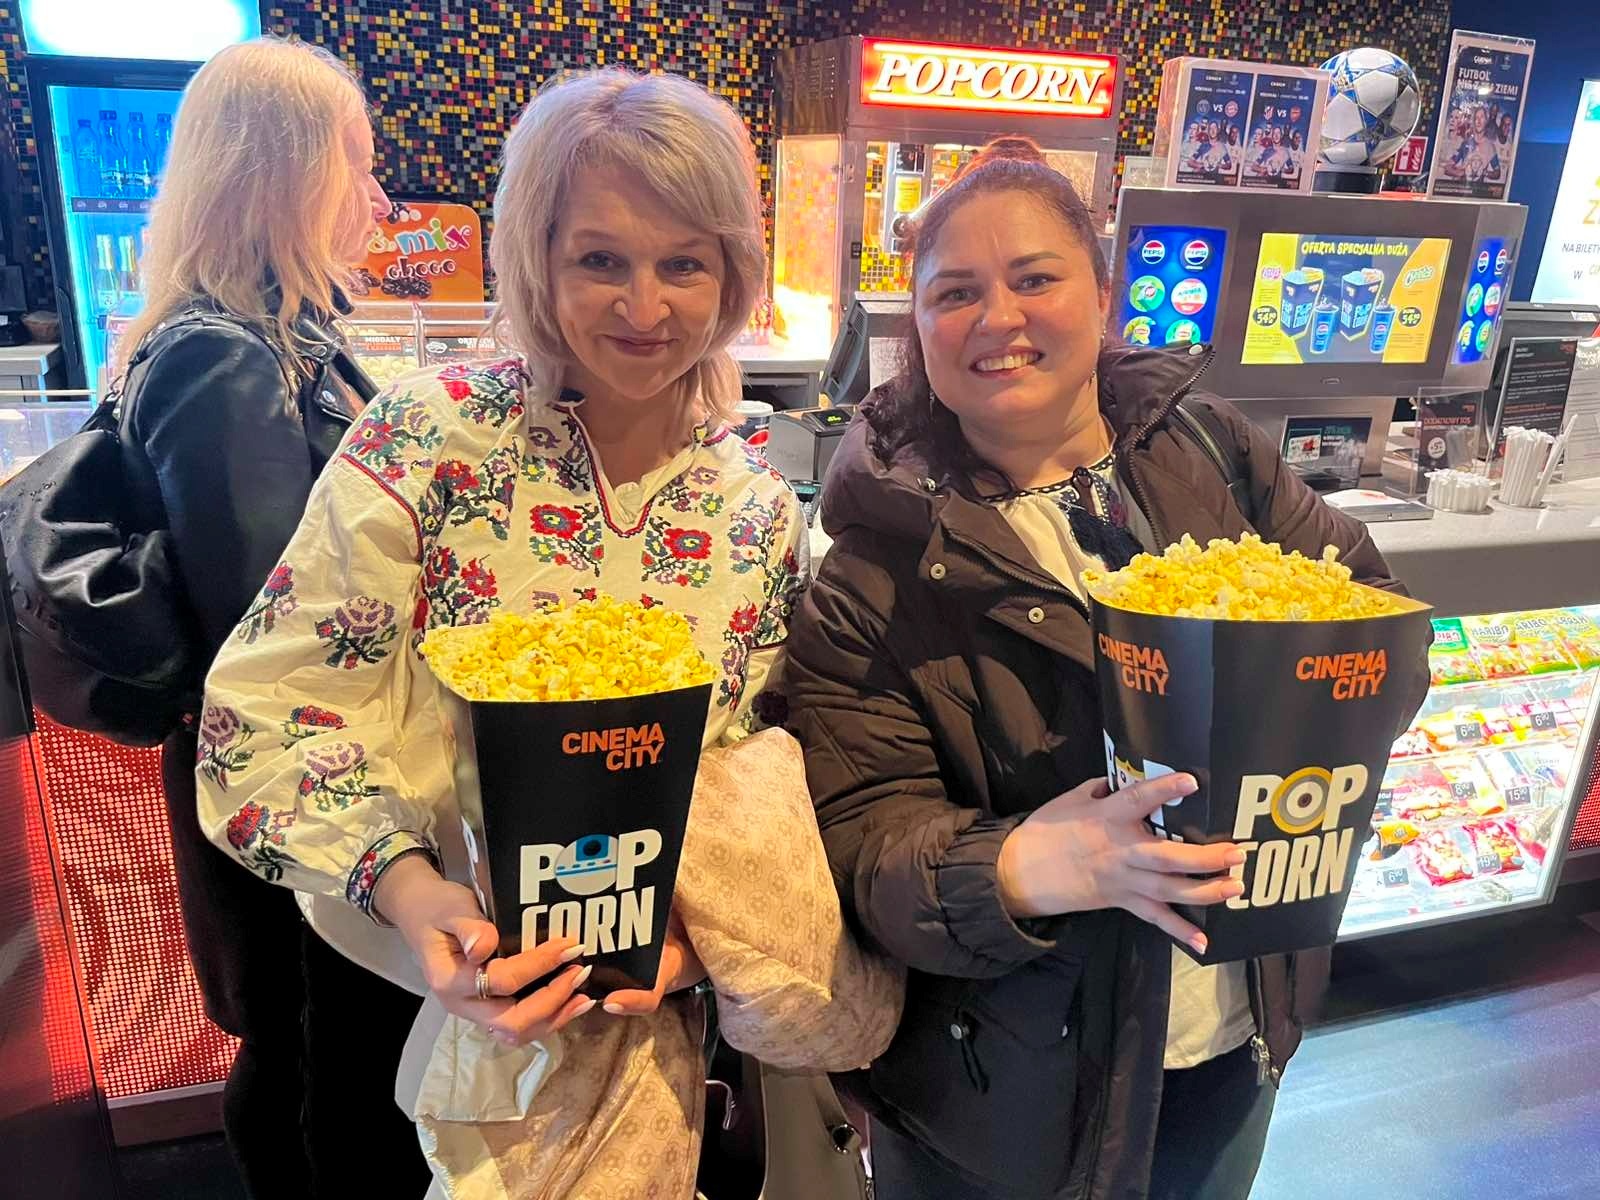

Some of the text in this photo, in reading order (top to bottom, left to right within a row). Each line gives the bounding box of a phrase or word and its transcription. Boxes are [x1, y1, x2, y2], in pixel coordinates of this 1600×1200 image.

[872, 54, 1103, 104] POPCORN
[1459, 68, 1491, 80] FUTBOL
[1495, 83, 1519, 96] ZIEMI
[1213, 104, 1223, 113] VS
[1277, 109, 1287, 117] VS
[394, 218, 472, 255] mix
[1301, 241, 1335, 255] OFERTA
[1386, 242, 1409, 256] DUŻA
[387, 256, 456, 280] choco
[1573, 270, 1583, 280] W
[1098, 632, 1169, 674] CINEMA
[1296, 649, 1388, 679] CINEMA
[1121, 665, 1169, 696] CITY
[1332, 674, 1387, 700] CITY
[561, 722, 665, 754] CINEMA
[606, 742, 665, 771] CITY
[1233, 764, 1368, 839] POP
[520, 829, 662, 904] POP
[521, 886, 655, 956] CORN
